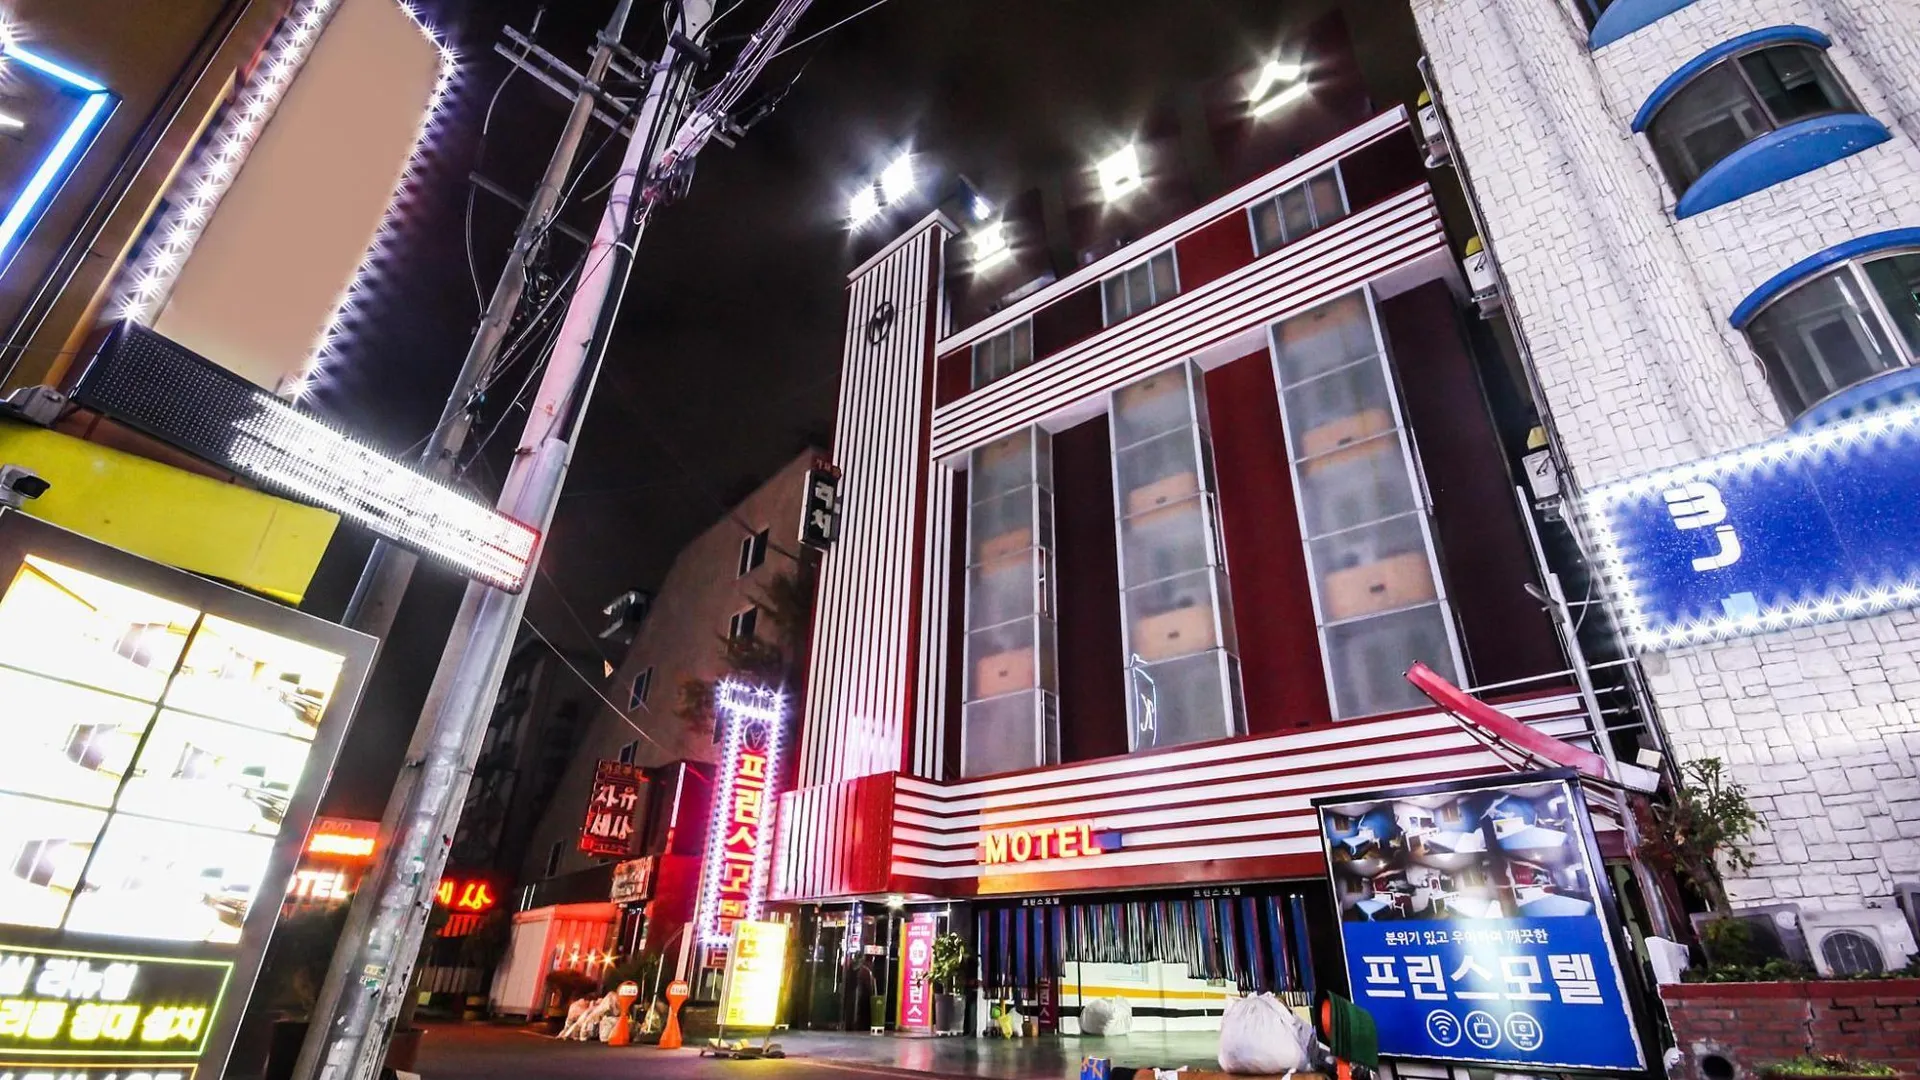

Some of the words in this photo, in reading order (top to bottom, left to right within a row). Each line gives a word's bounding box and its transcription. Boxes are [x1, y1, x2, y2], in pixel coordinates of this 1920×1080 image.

[984, 823, 1102, 865] MOTEL
[1385, 931, 1420, 946] 분위기
[1424, 930, 1449, 945] 있고
[1505, 928, 1549, 945] 깨끗한
[1362, 953, 1603, 1005] 프린스모텔
